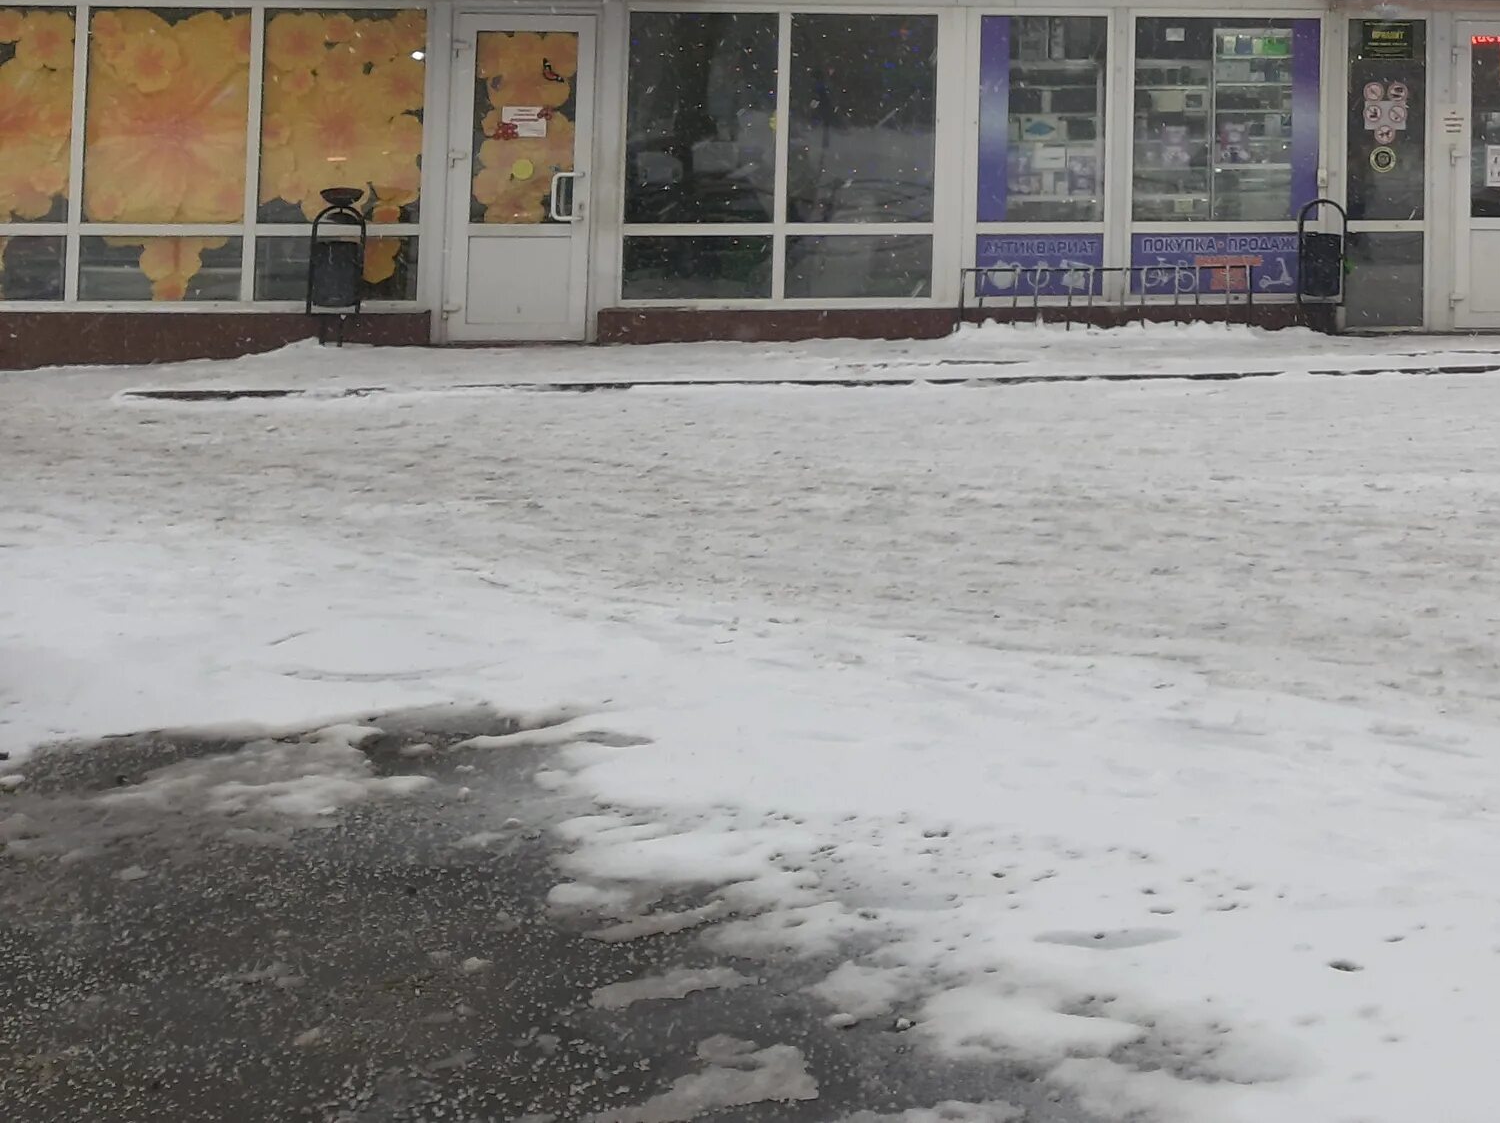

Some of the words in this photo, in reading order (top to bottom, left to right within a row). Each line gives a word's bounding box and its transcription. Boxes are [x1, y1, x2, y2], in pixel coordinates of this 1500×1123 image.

[982, 239, 1098, 256] АНТИКВАРИАТ
[1143, 236, 1218, 252] ПОКУПКА
[1227, 236, 1299, 252] ПРОДАЖ
